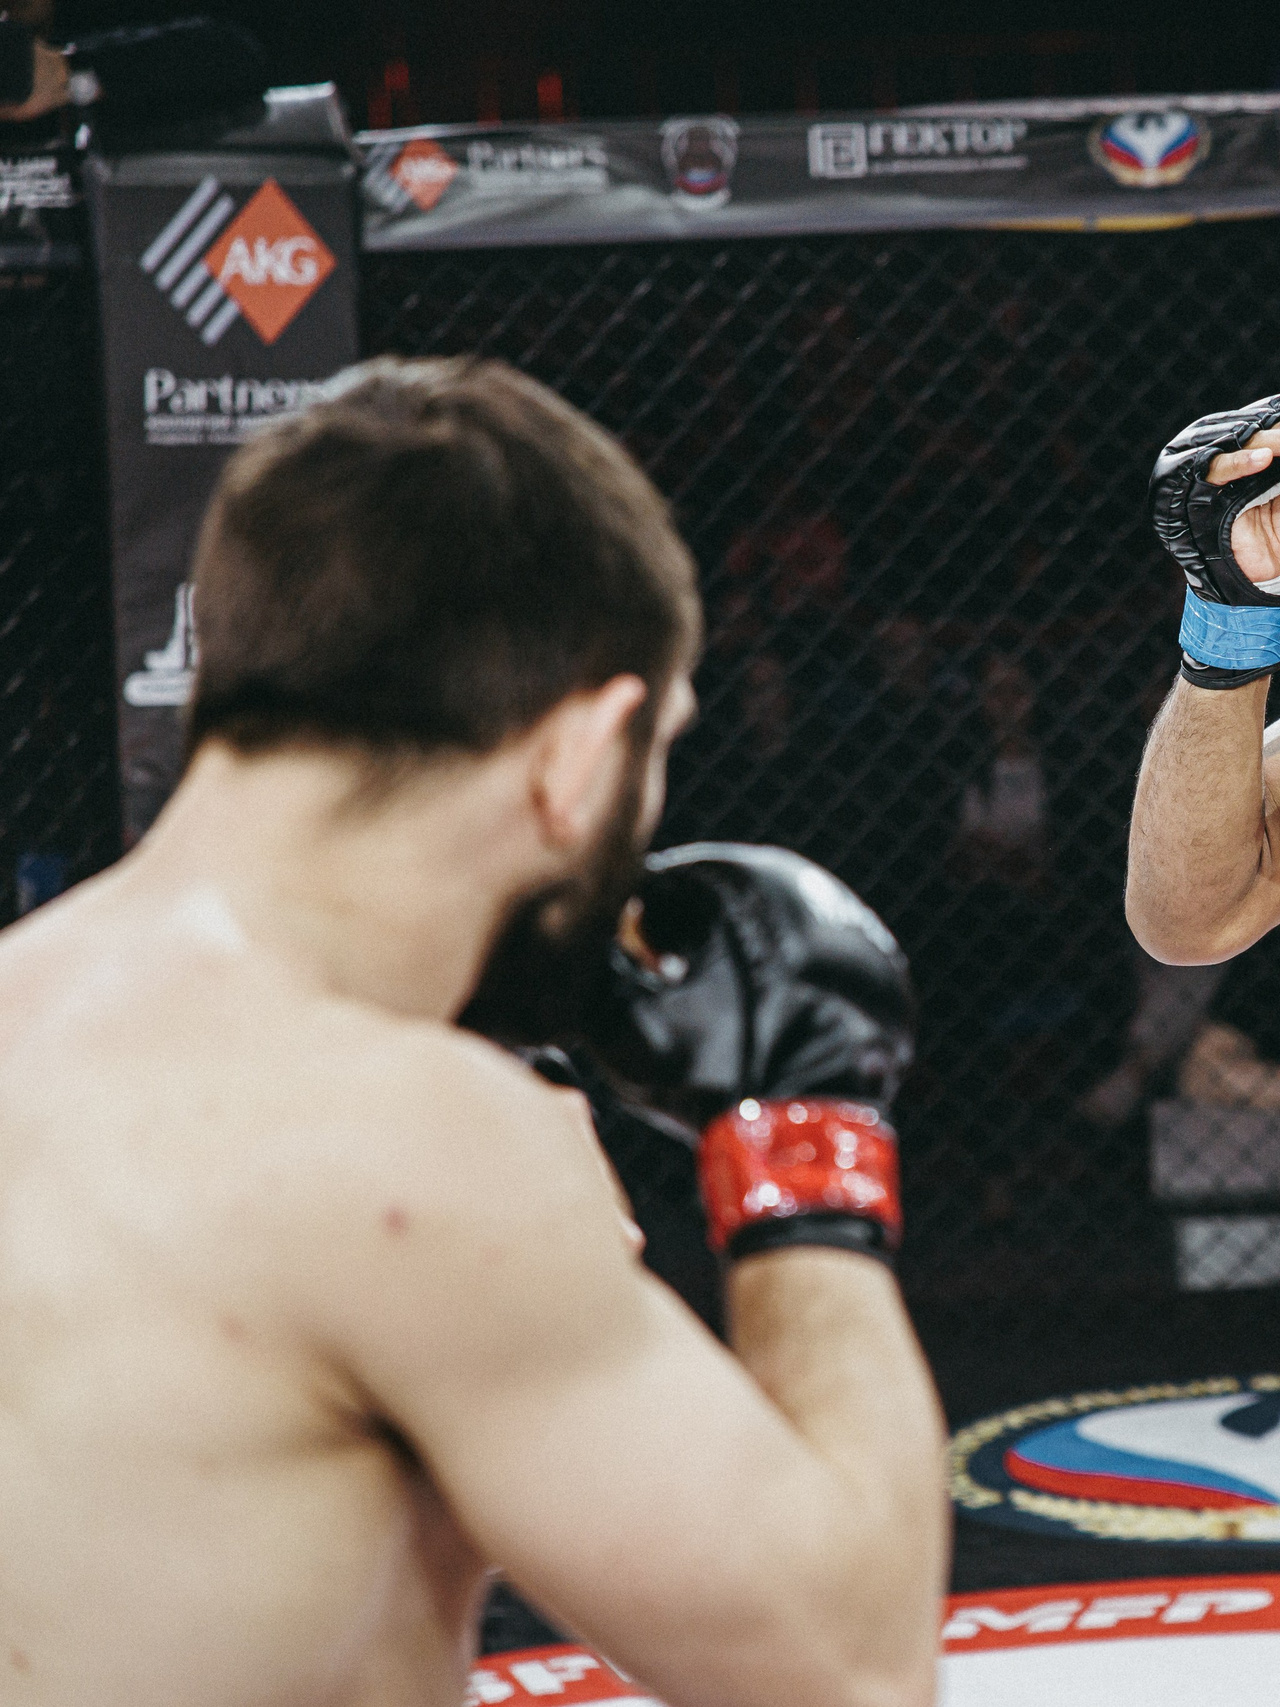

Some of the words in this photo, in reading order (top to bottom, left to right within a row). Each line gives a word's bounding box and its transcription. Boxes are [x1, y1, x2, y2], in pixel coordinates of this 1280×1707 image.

[221, 236, 317, 284] AKG
[143, 368, 326, 414] Partner
[941, 1588, 1274, 1640] MFP
